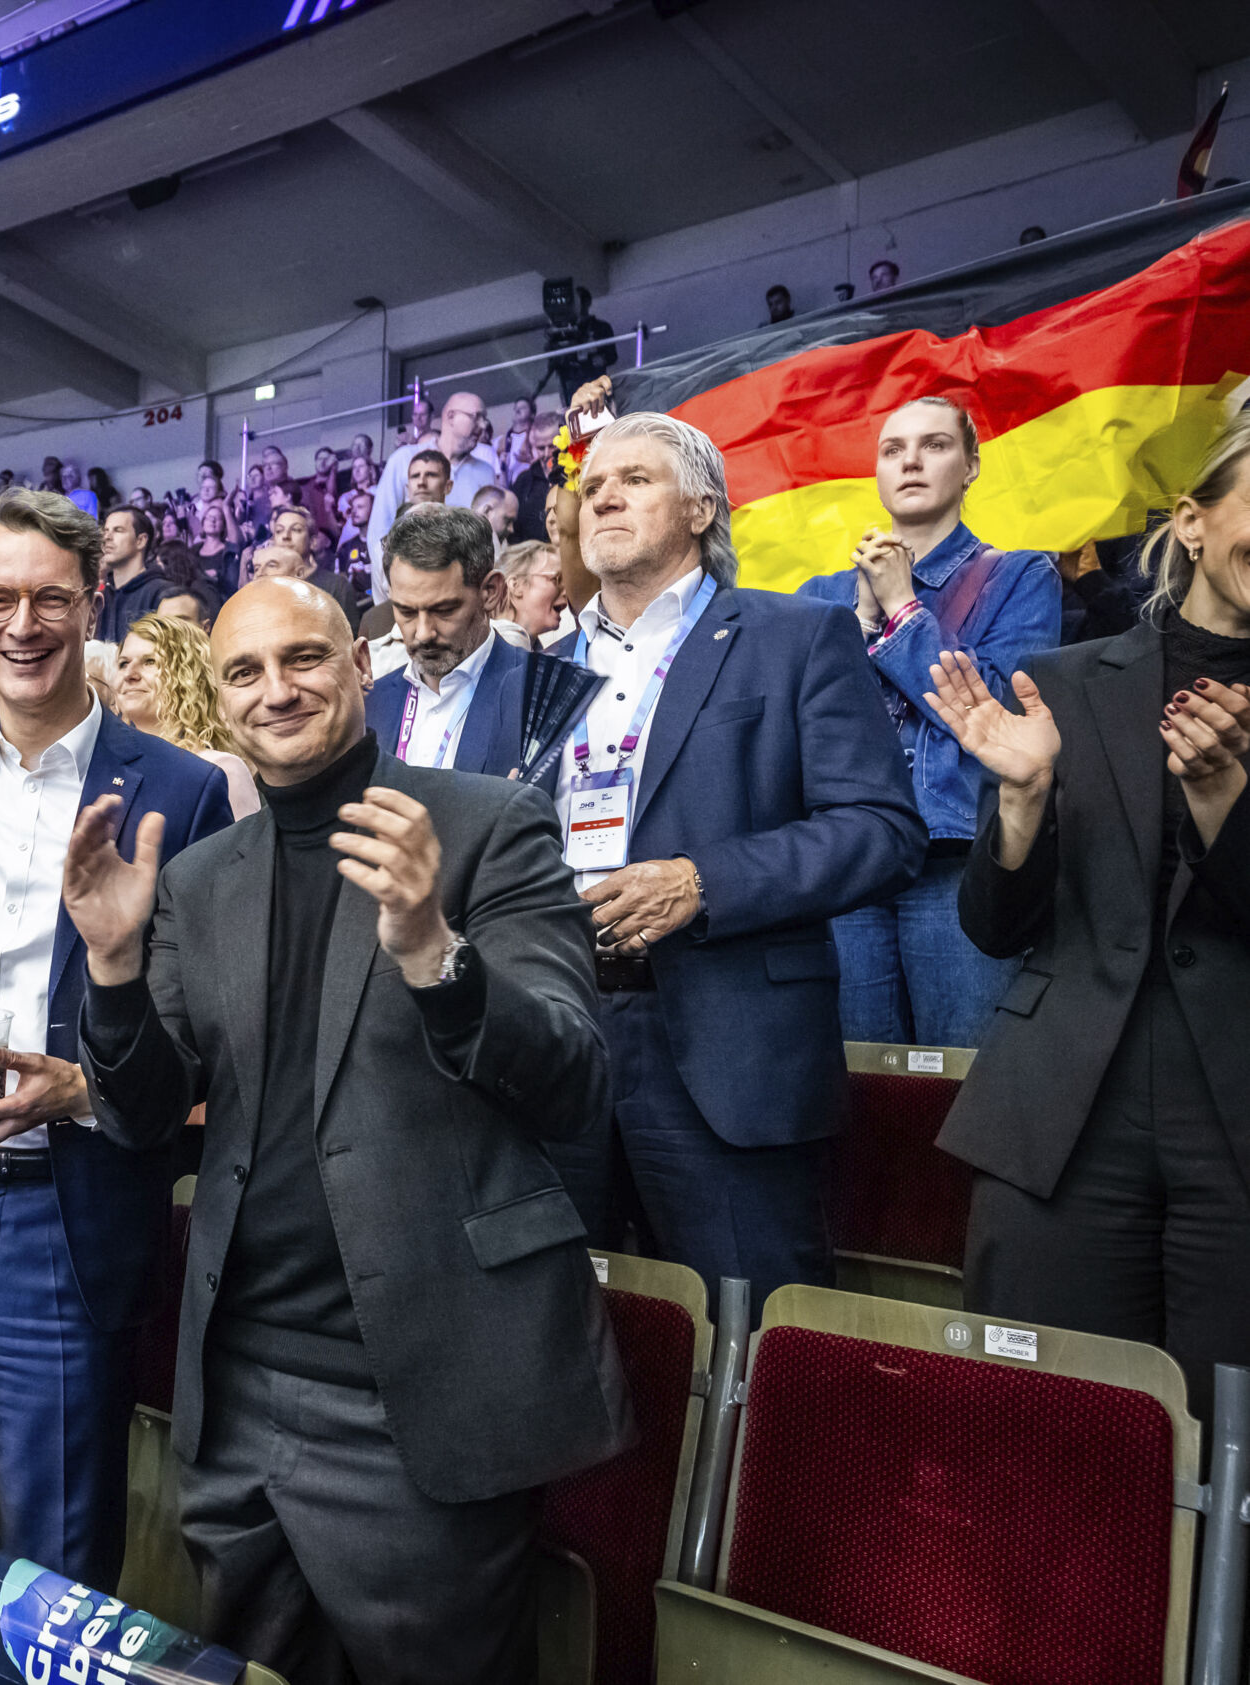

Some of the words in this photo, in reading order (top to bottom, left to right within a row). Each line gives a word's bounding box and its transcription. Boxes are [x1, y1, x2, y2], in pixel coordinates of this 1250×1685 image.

[142, 404, 183, 427] 204
[883, 1055, 899, 1066] 146
[949, 1328, 967, 1342] 131
[997, 1346, 1030, 1357] SCHOBER
